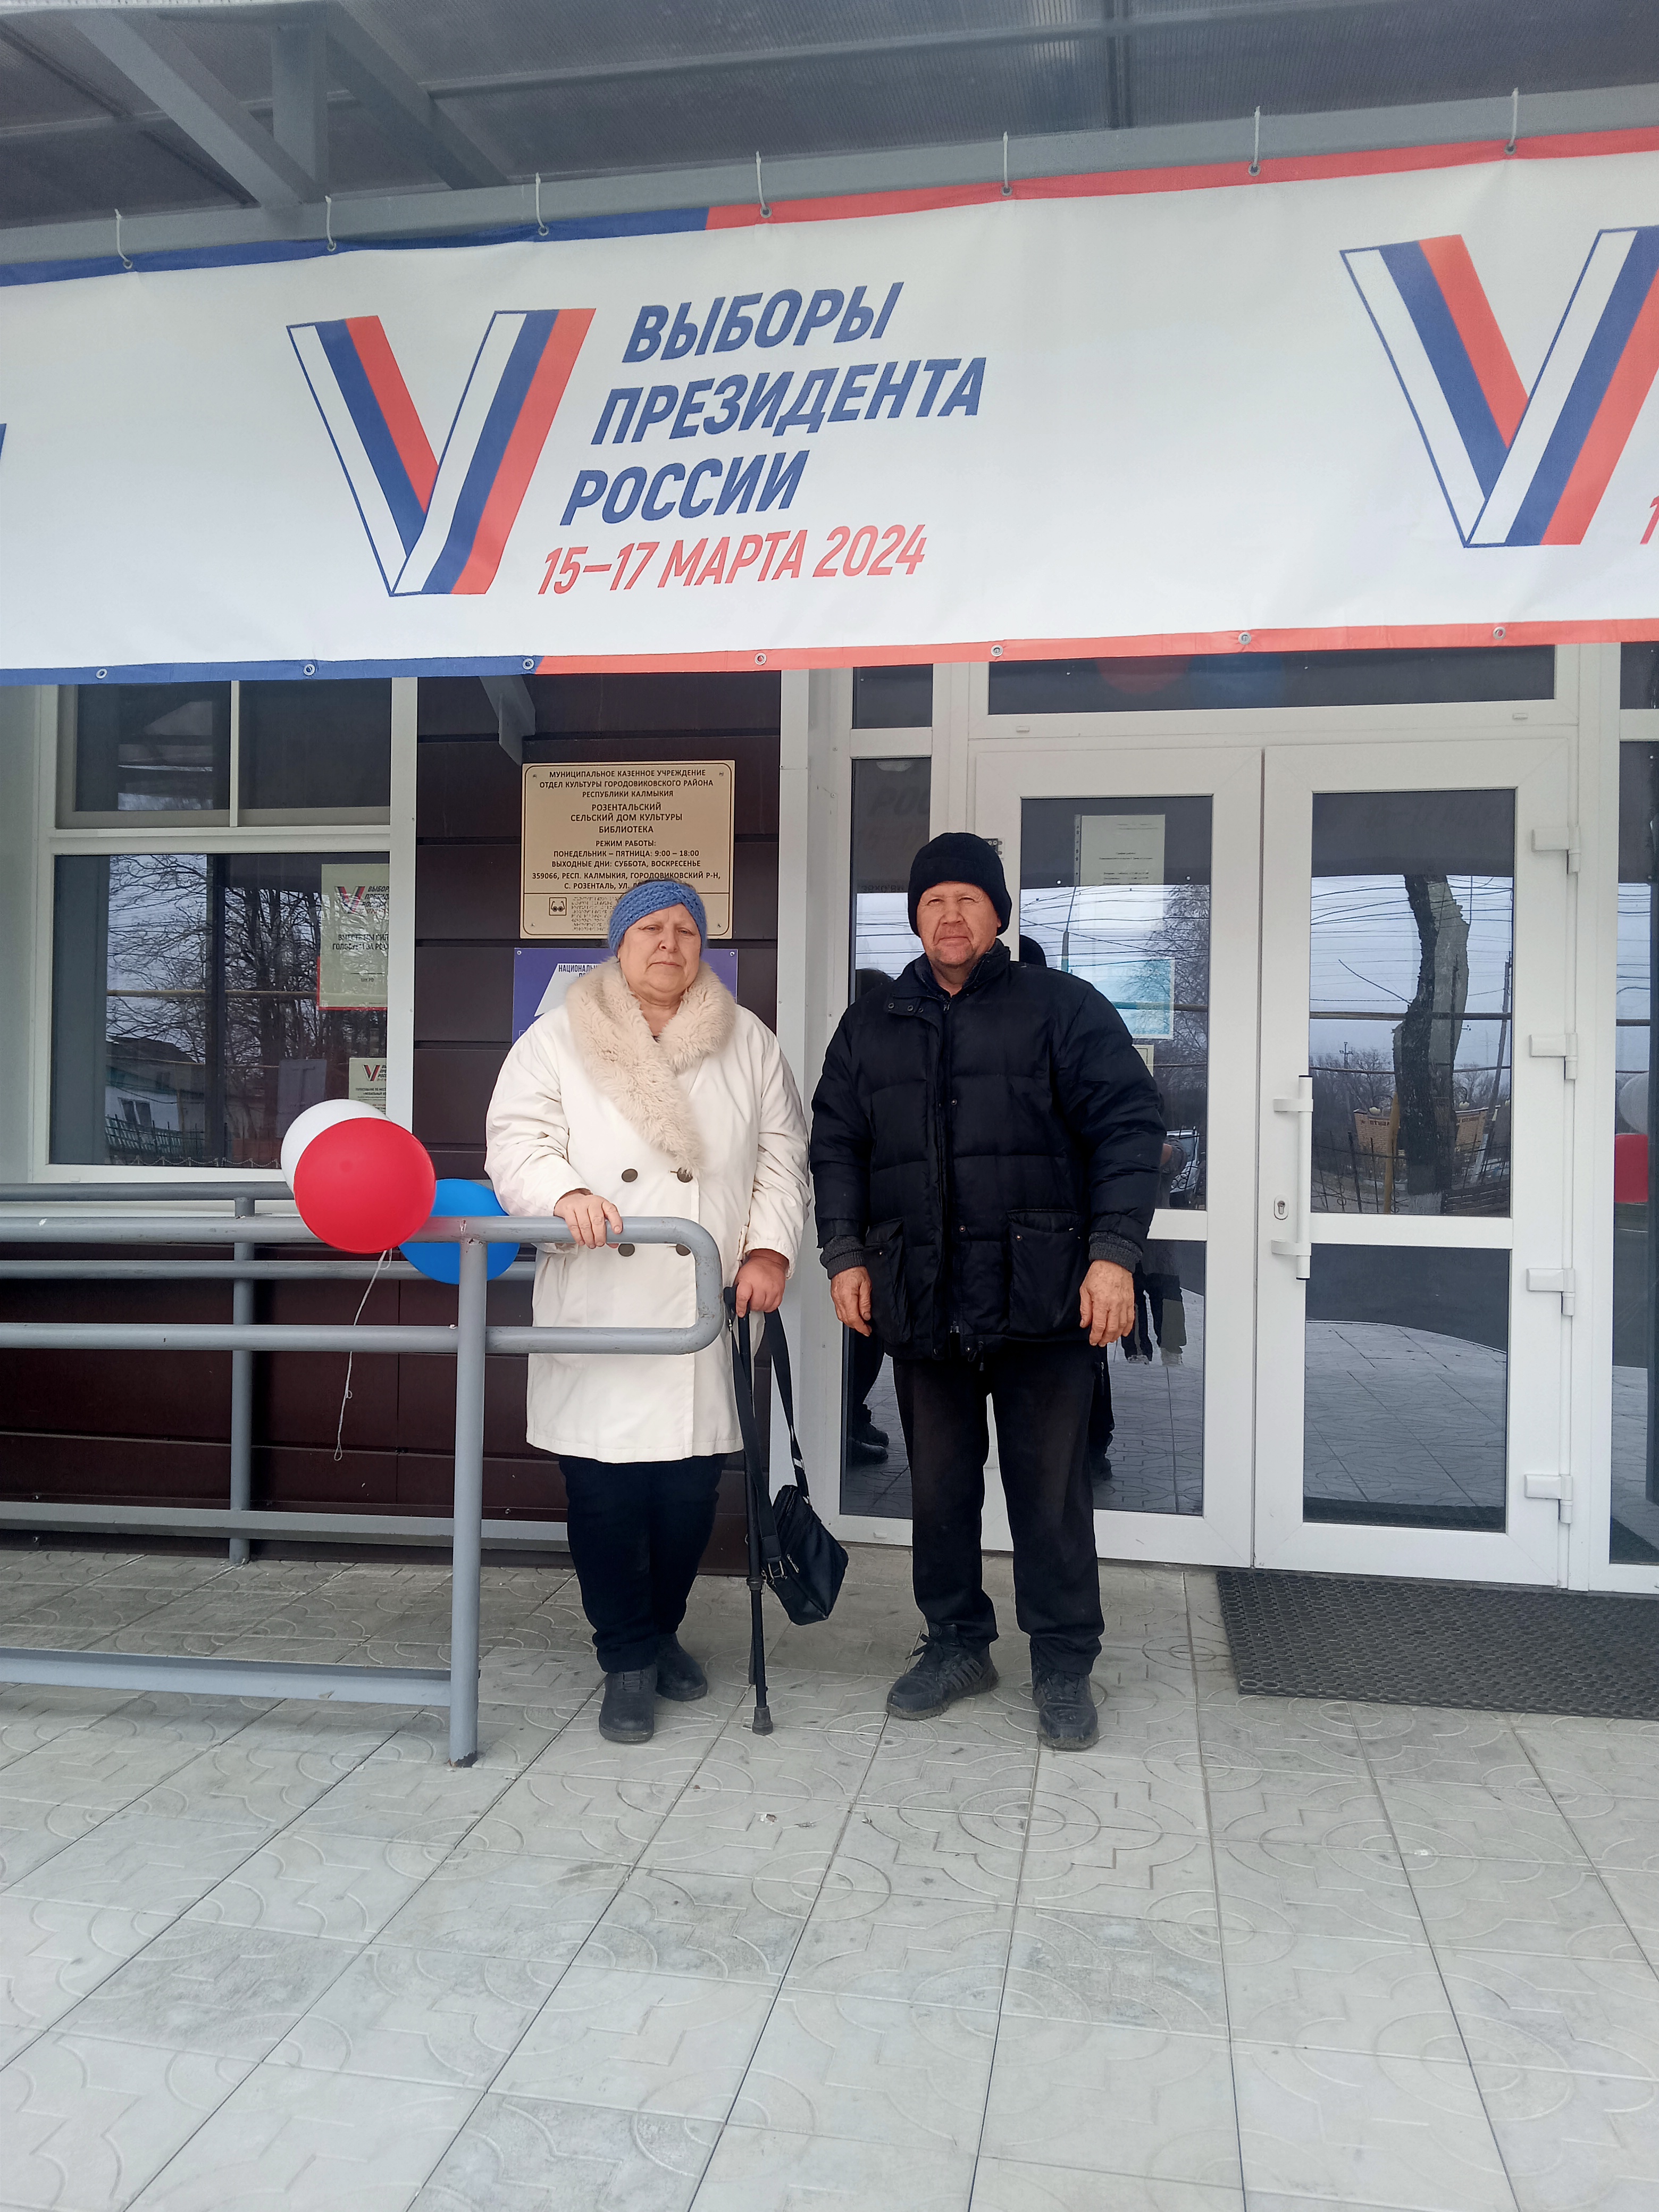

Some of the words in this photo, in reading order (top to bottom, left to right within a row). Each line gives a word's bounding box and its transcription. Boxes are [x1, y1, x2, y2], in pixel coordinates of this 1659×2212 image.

[622, 281, 904, 363] ВЫБОРЫ
[590, 357, 987, 445] ПРЕЗИДЕНТА
[559, 449, 810, 526] РОССИИ
[657, 529, 808, 588] МАРТА
[812, 524, 927, 577] 2024
[540, 781, 563, 789] ОТДЕЛ
[605, 780, 681, 788] ГОРОДОВИКОВСКОГО
[683, 778, 714, 786] РАЙОНА
[592, 802, 661, 811] РОЗЕНТАЛЬСКИЙ
[571, 812, 614, 822] СЕЛЬСКИЙ
[616, 814, 637, 823] ДОМ
[599, 825, 654, 834] БИБЛИОТЕКА
[615, 850, 652, 858] ПЯТНИЦА:
[552, 860, 591, 869] ВЫХОДНЫЕ
[594, 860, 612, 869] ДНИ:
[630, 870, 703, 879] ГОРОДОВИКОВСКИЙ
[572, 882, 616, 890] РОЗЕНТАЛЬ,
